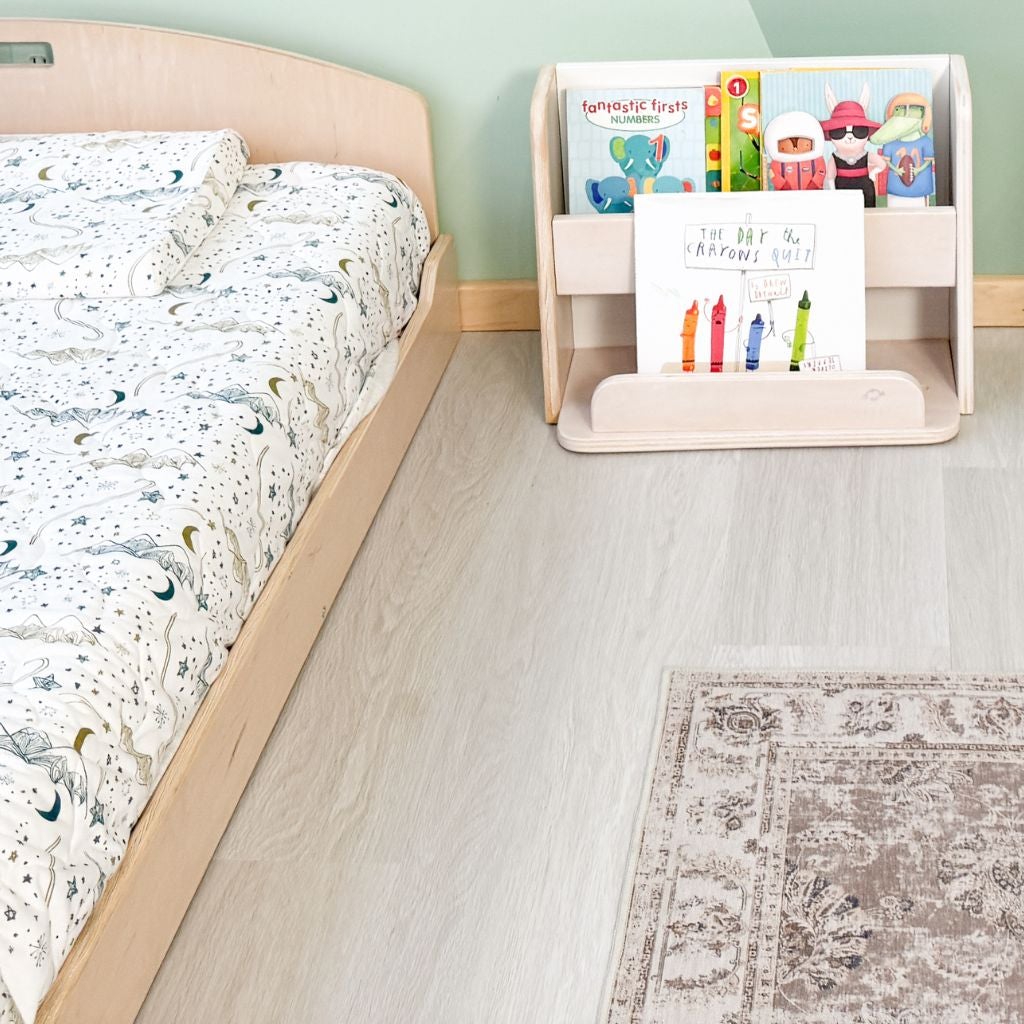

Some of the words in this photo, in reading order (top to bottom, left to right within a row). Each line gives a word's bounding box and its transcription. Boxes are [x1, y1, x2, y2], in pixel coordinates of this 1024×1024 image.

[732, 81, 740, 94] 1
[582, 100, 647, 114] fantastic
[651, 99, 688, 114] firsts
[610, 115, 660, 125] NUMBERS
[649, 133, 665, 163] 1
[700, 228, 724, 241] THE
[737, 226, 768, 246] DAY
[783, 227, 800, 245] the
[687, 241, 760, 264] CRAYONS
[771, 247, 811, 268] QUIT
